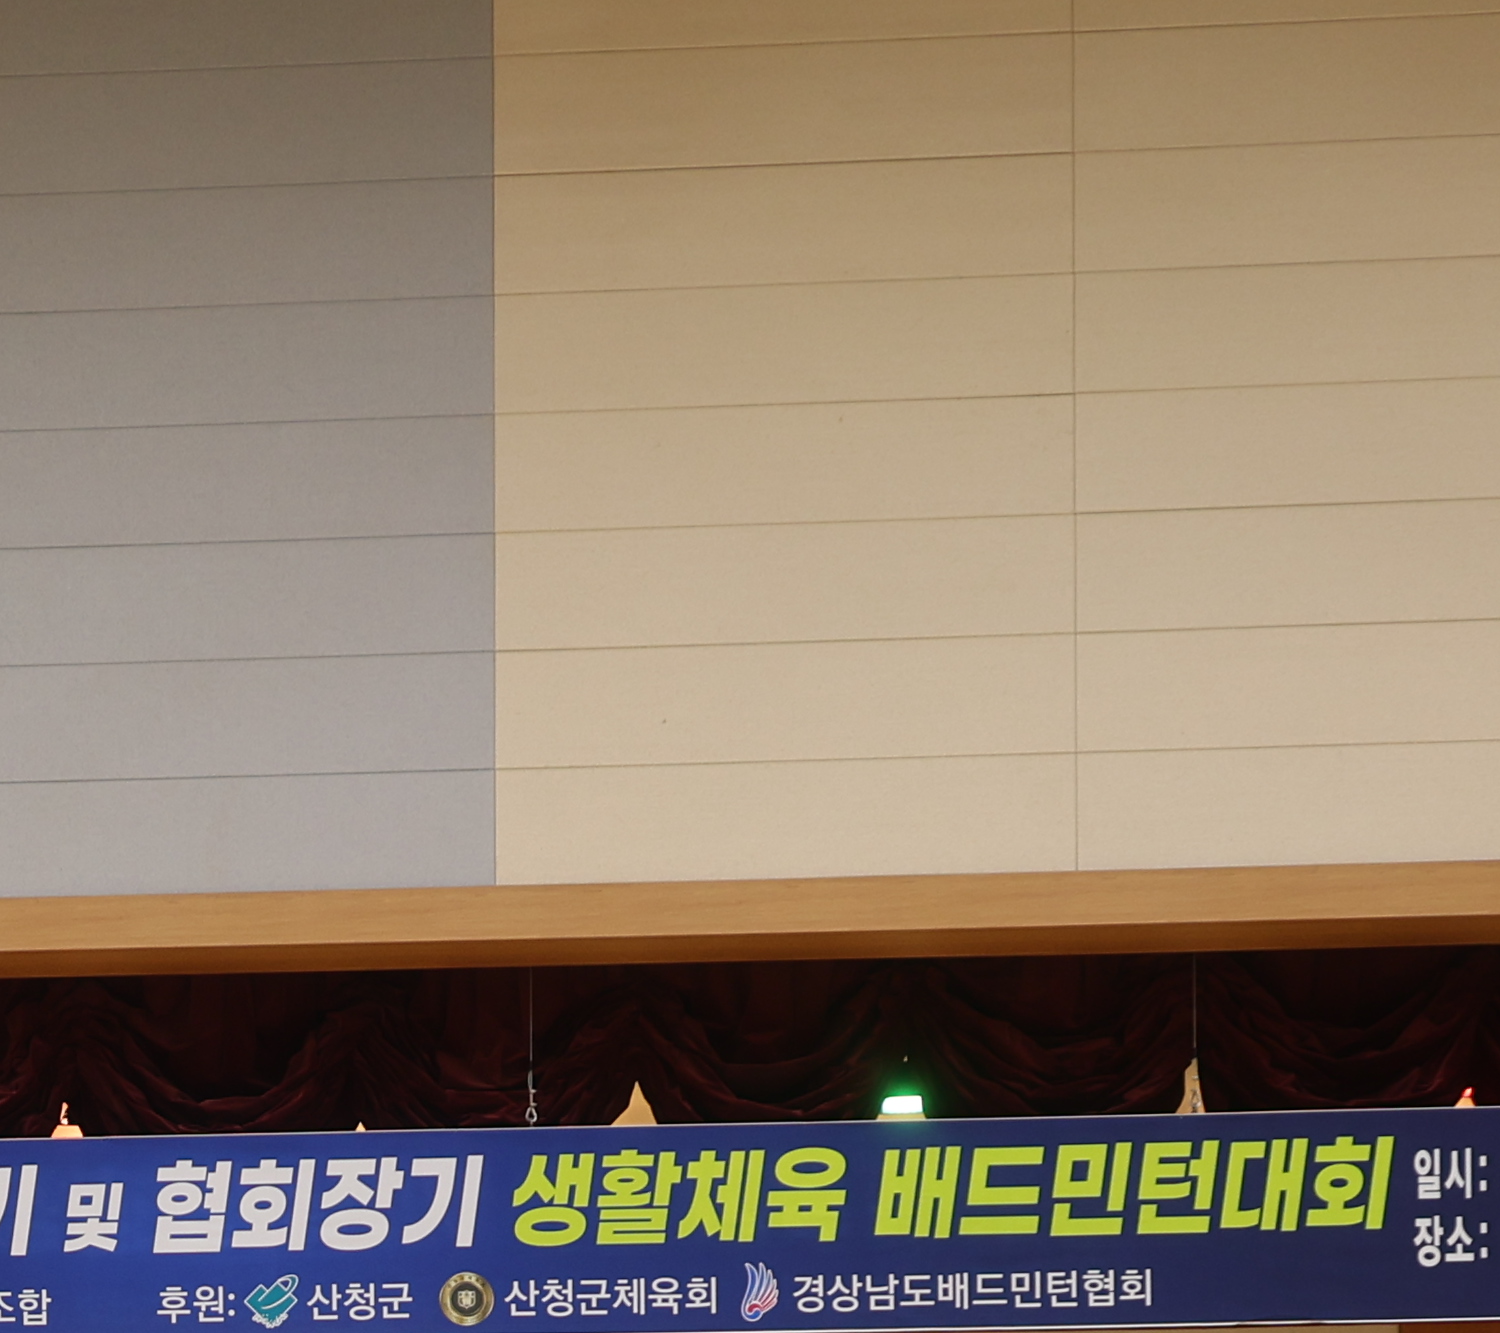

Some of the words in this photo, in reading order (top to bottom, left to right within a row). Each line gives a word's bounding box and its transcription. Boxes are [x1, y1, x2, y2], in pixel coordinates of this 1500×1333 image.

[63, 1182, 124, 1254] 및
[152, 1154, 484, 1255] 협회장기
[512, 1147, 846, 1248] 생활체육
[874, 1136, 1394, 1240] 배드민턴대회
[1414, 1147, 1487, 1201] 일시:
[1413, 1215, 1488, 1268] 장소:
[156, 1285, 236, 1325] 후원:
[306, 1282, 413, 1322] 산청군
[504, 1276, 717, 1318] 산청군체육회
[792, 1268, 1152, 1314] 경상남도배드민턴협회
